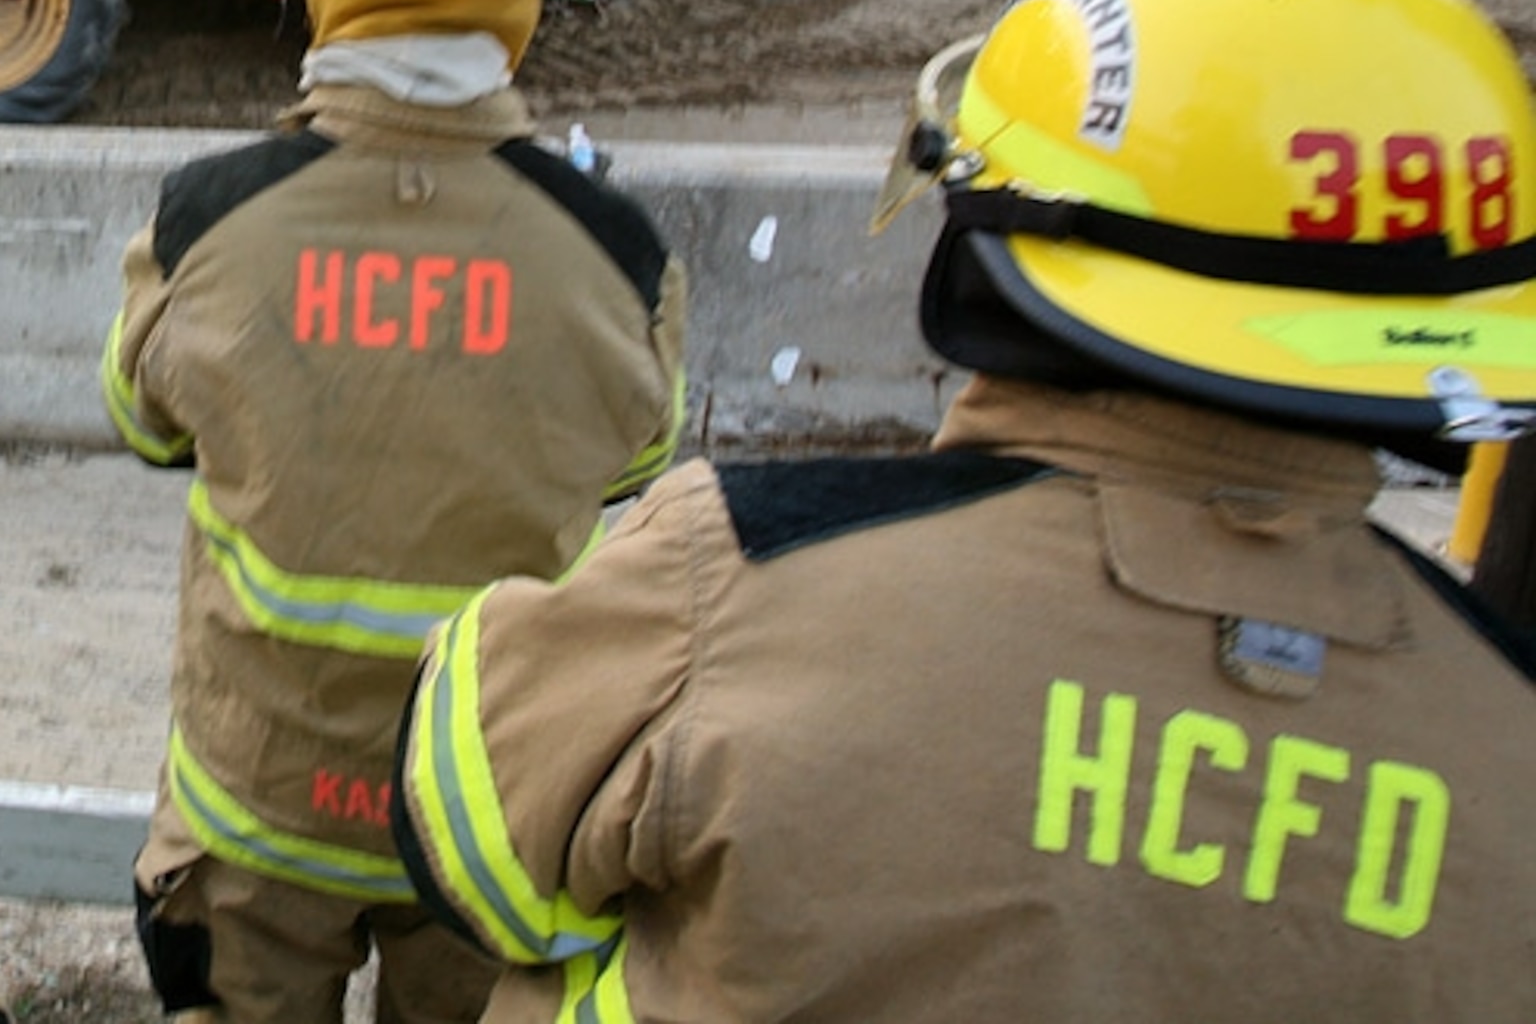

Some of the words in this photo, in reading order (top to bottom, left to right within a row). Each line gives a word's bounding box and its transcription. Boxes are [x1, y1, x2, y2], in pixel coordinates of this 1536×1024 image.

[1290, 131, 1514, 251] 398
[294, 248, 511, 355] HCFD
[1032, 679, 1451, 939] HCFD
